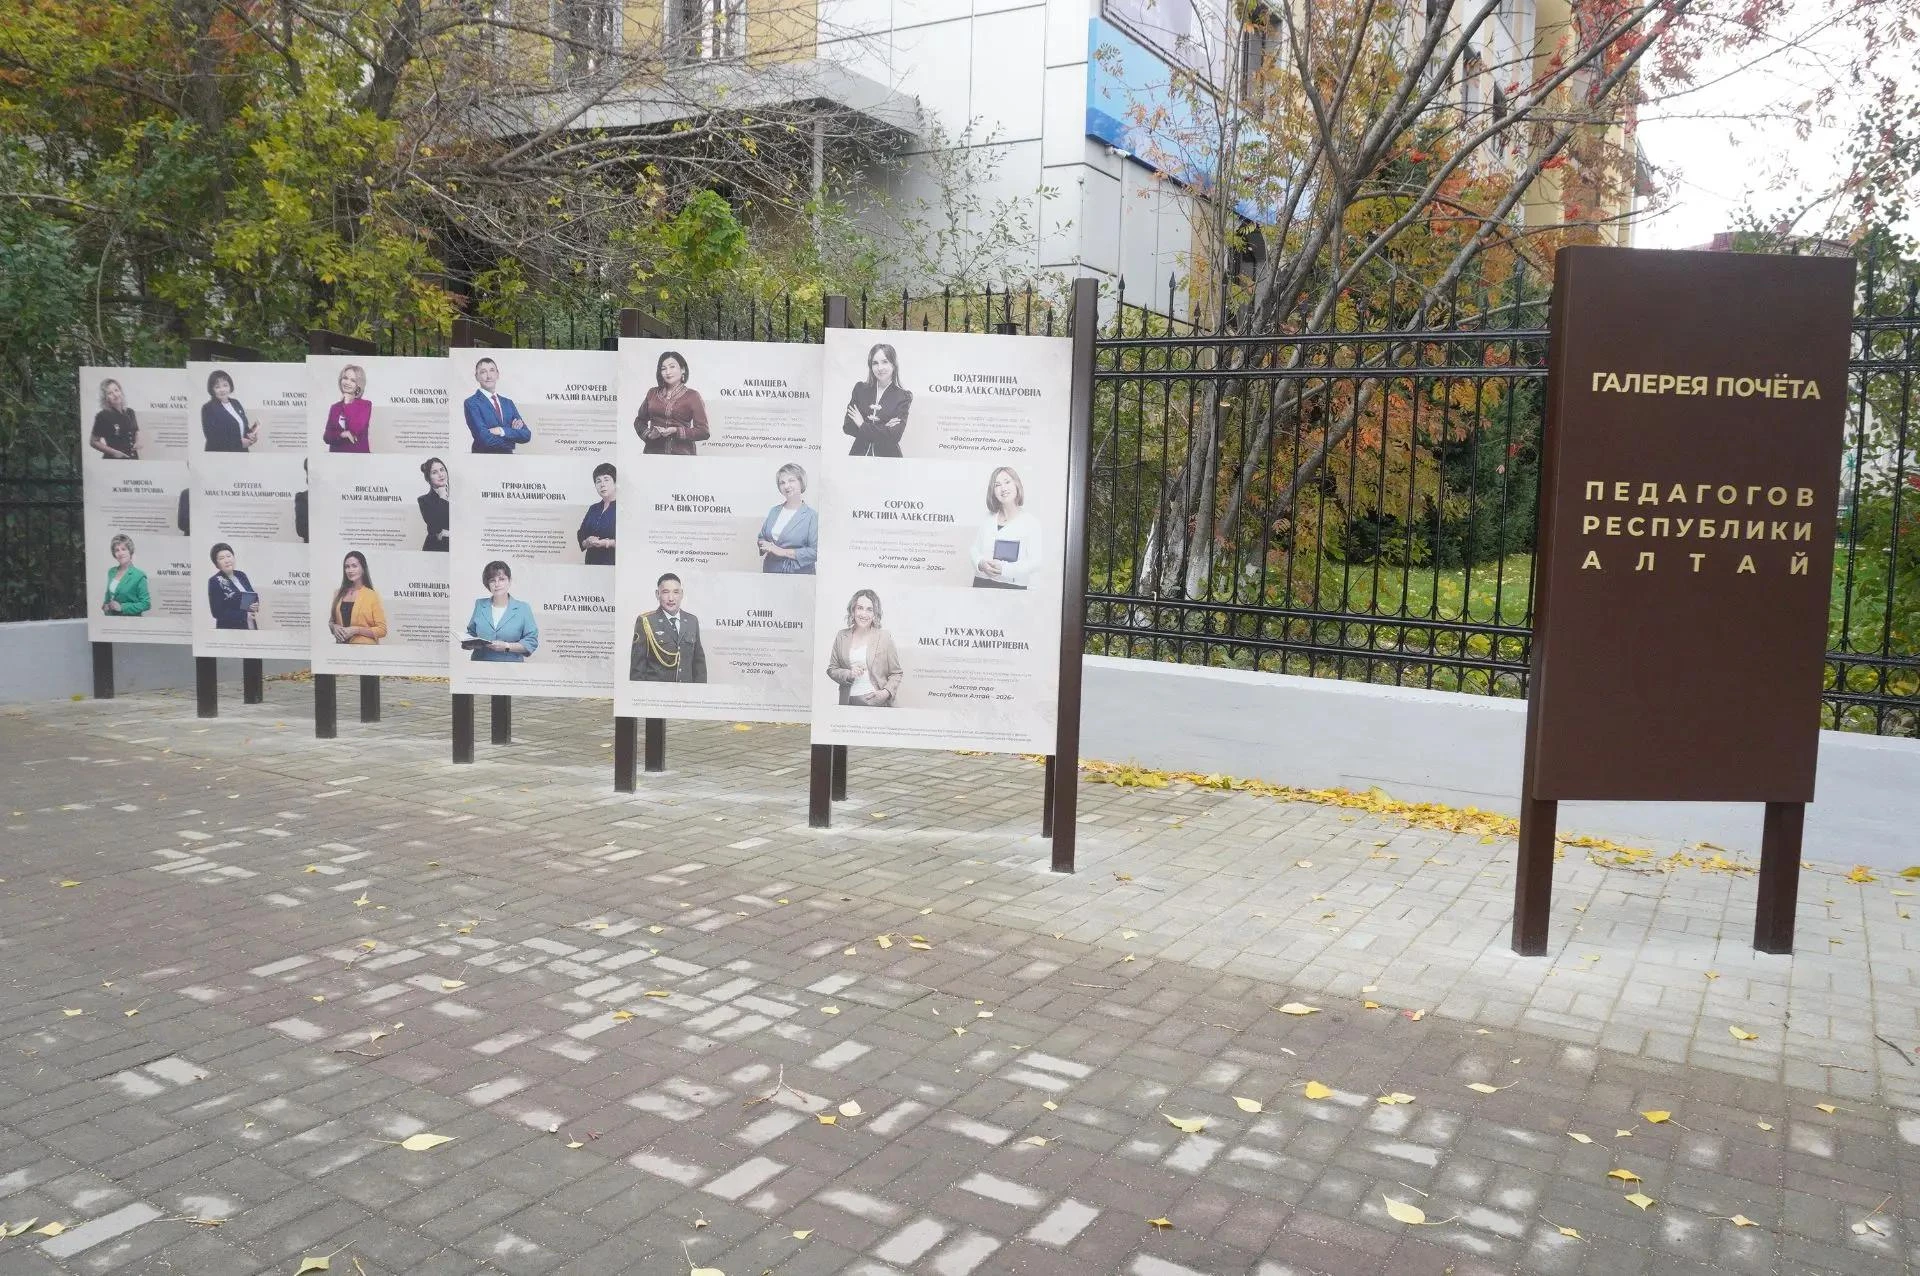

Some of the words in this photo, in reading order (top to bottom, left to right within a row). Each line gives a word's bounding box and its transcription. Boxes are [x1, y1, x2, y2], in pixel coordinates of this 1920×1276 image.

[953, 373, 1018, 384] ПОДТЯНИГИНА
[565, 383, 608, 392] ДОРОФЕЕВ
[928, 384, 963, 394] СОФЬЯ
[964, 385, 1042, 397] АЛЕКСАНДРОВНА
[1591, 372, 1708, 396] ГАЛЕРЕЯ
[1716, 373, 1821, 400] ПОЧЁТА
[545, 392, 580, 401] АРКАДИЙ
[720, 388, 753, 397] ОКСАНА
[755, 389, 811, 399] КУРДАКОВНА
[745, 442, 783, 450] Республики
[938, 443, 980, 452] Республики
[980, 444, 1002, 452] Алтай
[501, 482, 547, 490] ТРИФАНОВА
[481, 491, 505, 499] ИРИНА
[506, 492, 566, 501] ВЛАДИМИРОВНА
[671, 493, 715, 503] ЧЕКОНОВА
[1585, 481, 1814, 507] ПЕДАГОГОВ
[654, 503, 675, 512] ВЕРА
[676, 504, 732, 514] ВИКТОРОВНА
[884, 500, 924, 510] СОРОКО
[852, 510, 898, 521] КРИСТИНА
[900, 512, 955, 523] АЛЕКСЕЕВНА
[1582, 515, 1812, 541] РЕСПУБЛИКИ
[857, 561, 899, 570] Республики
[563, 594, 605, 603] ГЛАЗУНОВА
[543, 603, 577, 612] ВАРВАРА
[746, 609, 773, 618] САНИН
[715, 618, 744, 627] БАТЫР
[745, 619, 804, 629] АНАТОЛЬЕВИЧ
[918, 637, 970, 648] АНАСТАСИЯ
[971, 640, 1029, 651] ДМИТРИЕВНА
[927, 691, 969, 699] Республики
[969, 692, 990, 700] Алтай
